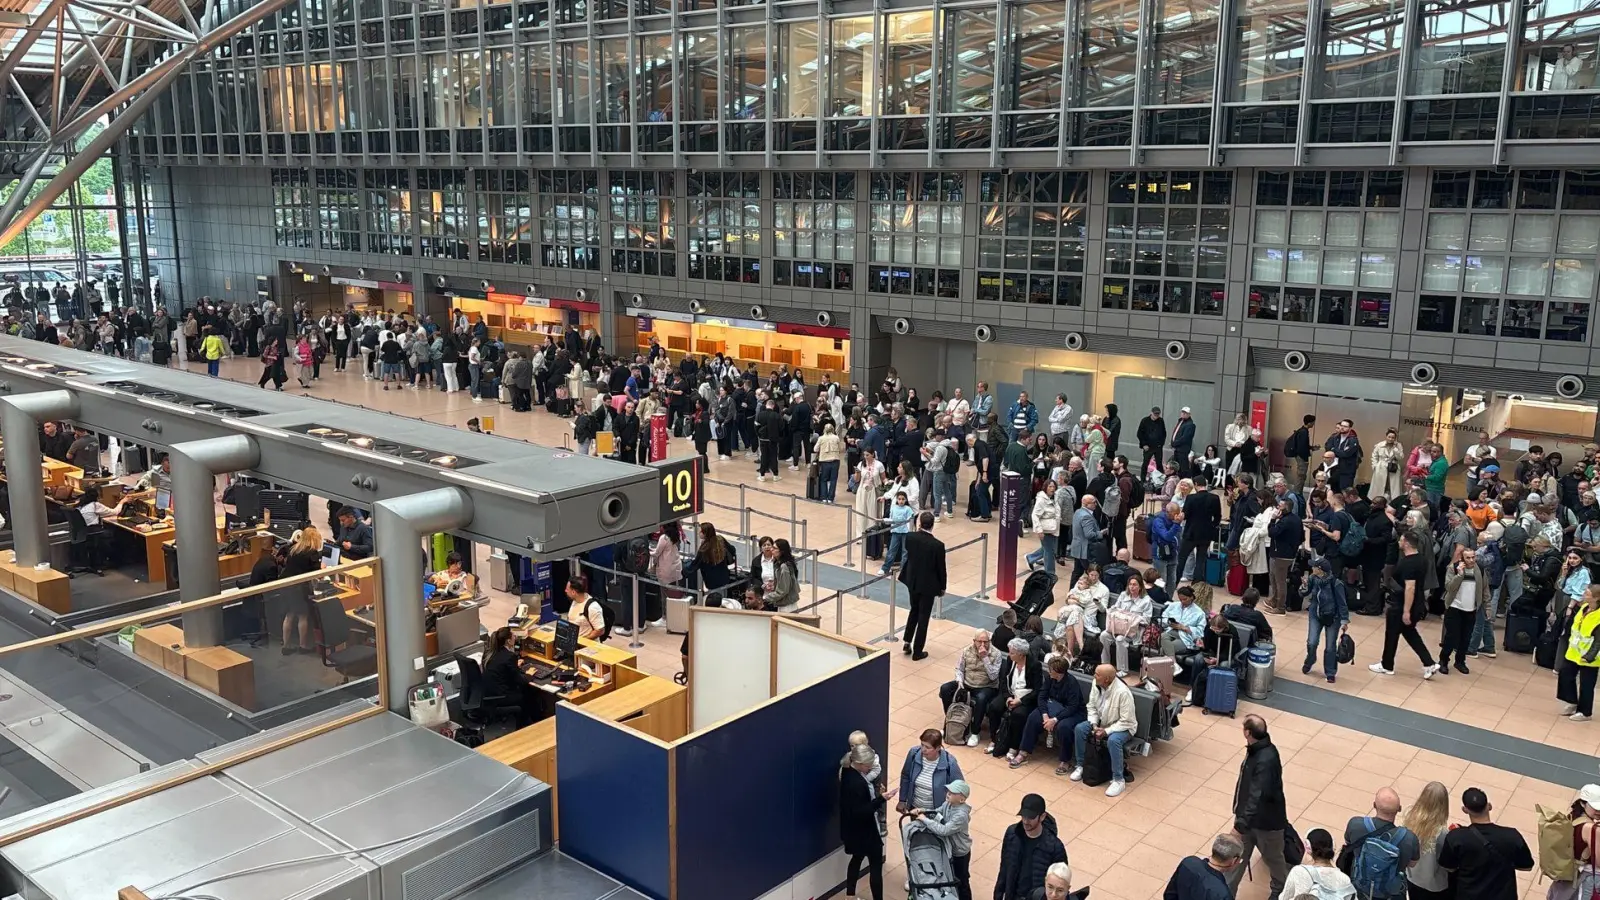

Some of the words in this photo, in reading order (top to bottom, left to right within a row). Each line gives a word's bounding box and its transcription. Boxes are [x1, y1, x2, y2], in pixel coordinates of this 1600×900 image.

[1404, 418, 1485, 433] PARKLEITZENTRALE
[651, 426, 659, 459] Economy
[662, 470, 692, 504] 10
[1000, 490, 1008, 527] Business
